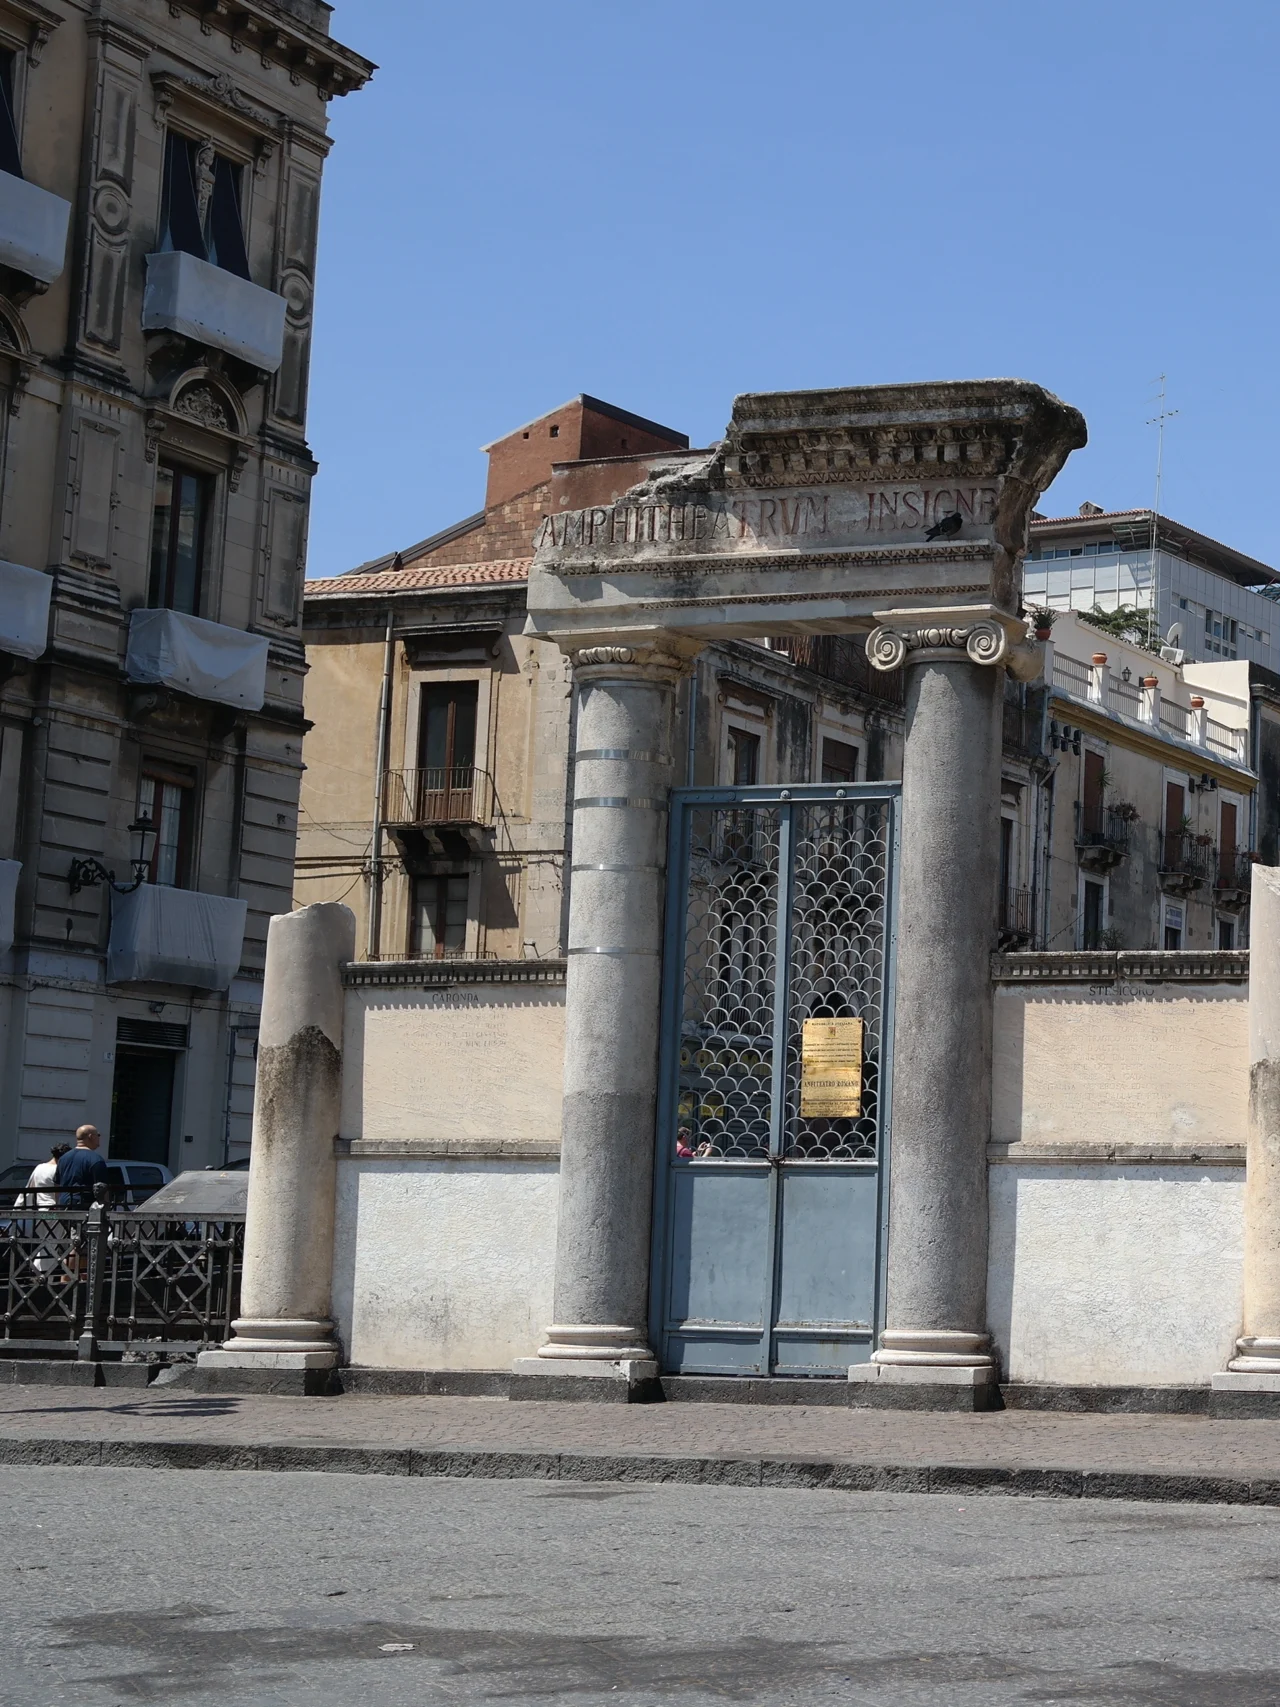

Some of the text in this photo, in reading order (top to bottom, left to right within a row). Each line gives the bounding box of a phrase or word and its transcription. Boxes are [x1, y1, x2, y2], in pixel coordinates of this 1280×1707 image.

[865, 487, 998, 531] INSIGNE
[1089, 985, 1155, 997] STESICORO
[432, 992, 479, 1003] CARONDA
